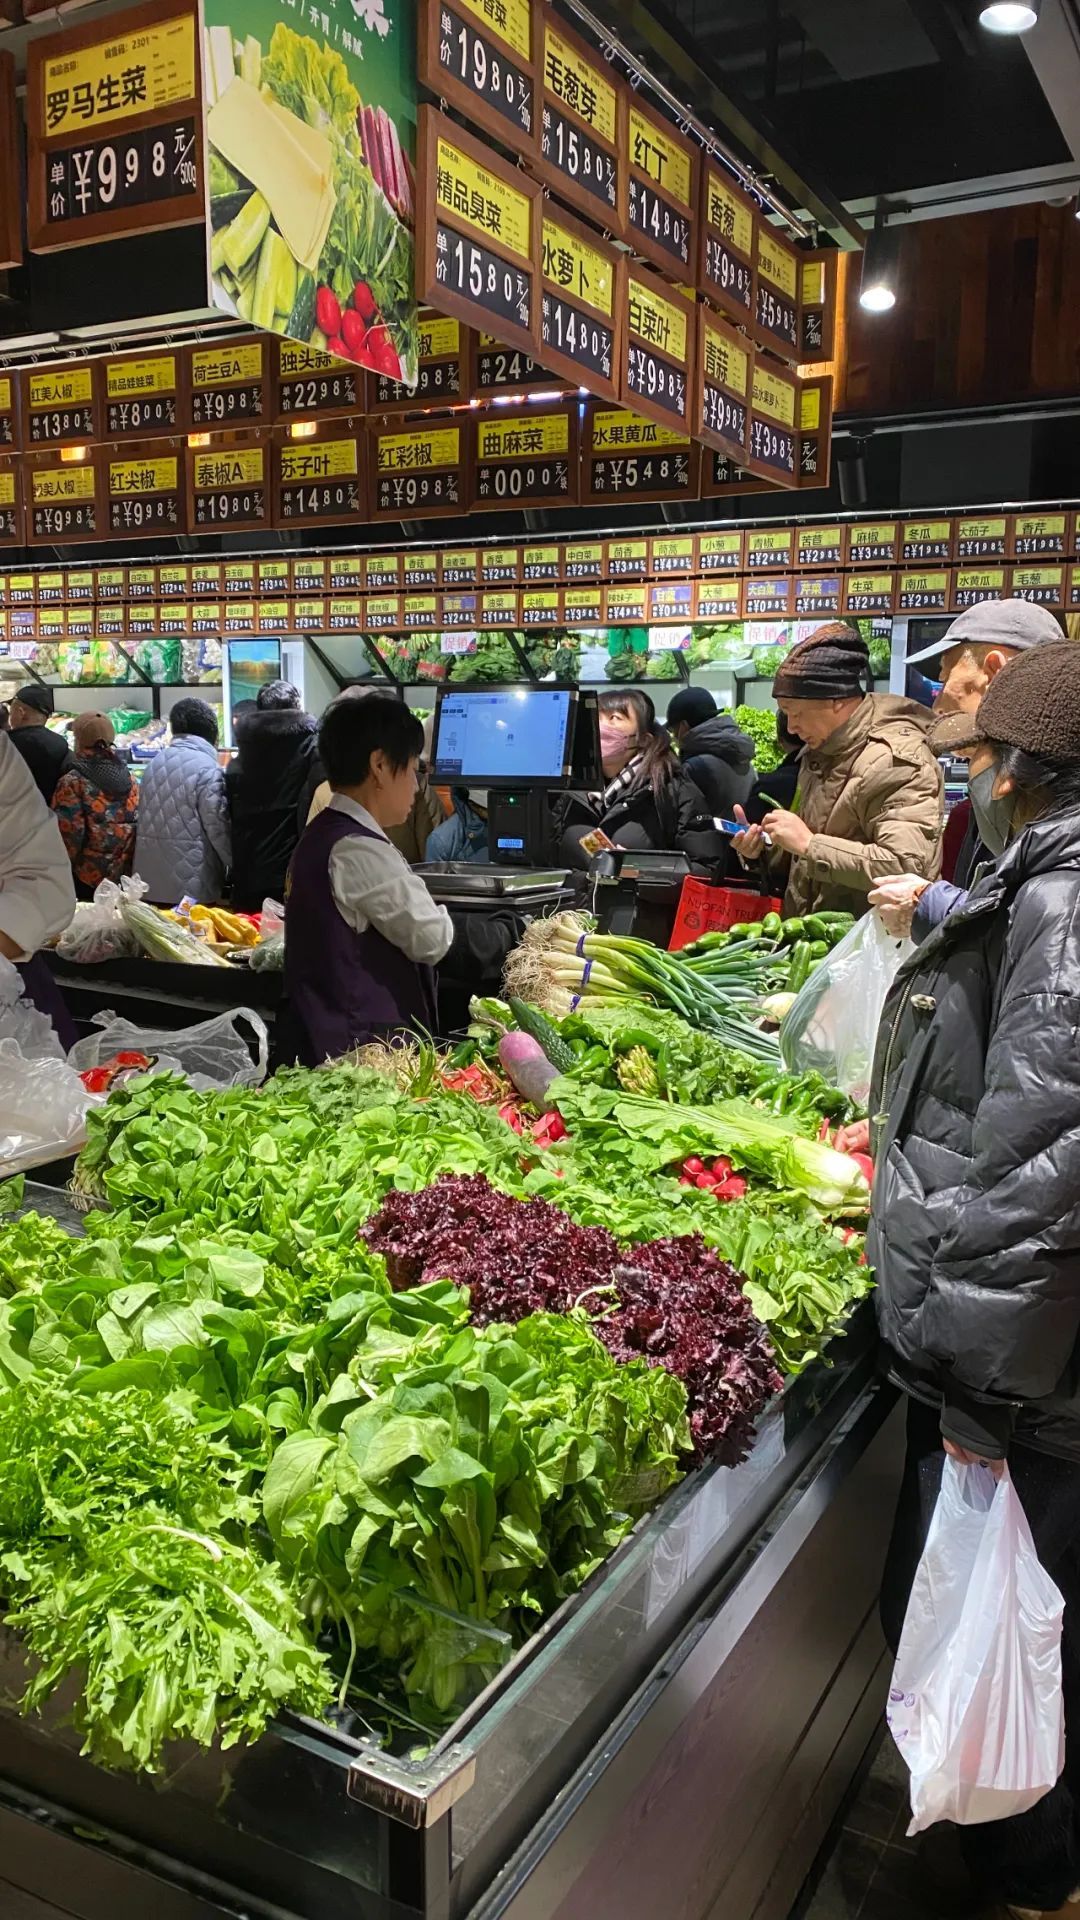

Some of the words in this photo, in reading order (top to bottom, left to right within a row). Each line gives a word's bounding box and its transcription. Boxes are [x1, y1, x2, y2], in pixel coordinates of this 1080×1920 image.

[440, 11, 452, 65] 单价
[458, 27, 514, 103] 19.80
[46, 64, 147, 129] 罗马生菜
[545, 51, 597, 124] 毛葱芽
[541, 108, 551, 155] 单价
[173, 126, 197, 187] 元/500g
[556, 122, 603, 181] 15.80
[634, 131, 668, 184] 红丁
[50, 161, 65, 217] 单价
[72, 140, 165, 214] ¥9.98
[437, 166, 502, 235] 精品臭菜
[640, 190, 679, 244] 14.80
[711, 192, 735, 242] 香葱
[436, 231, 448, 282] 单价
[541, 239, 589, 297] 水萝卜
[713, 241, 744, 290] ¥9.98
[455, 240, 512, 302] 15.80
[516, 275, 529, 327] 元/500g
[760, 287, 789, 329] ¥5.98
[542, 298, 550, 342] 单价
[554, 305, 598, 356] 14.80
[629, 297, 670, 351] 白菜叶
[805, 315, 821, 346] 元/500g
[194, 360, 241, 383] 荷兰豆A
[281, 349, 332, 373] 独头蒜
[481, 358, 491, 384] 单价
[637, 349, 674, 396] ¥9.98
[705, 340, 729, 384] 青蒜
[31, 384, 73, 402] 红美人椒
[108, 374, 155, 393] 精品娃娃菜
[282, 385, 291, 410] 单价
[294, 380, 341, 409] 22.98
[119, 403, 162, 431] ¥8.00
[203, 392, 247, 420] ¥9.98
[709, 388, 737, 430] ¥9.98
[42, 413, 81, 438] 13.80
[592, 423, 657, 445] 水果黄瓜
[754, 421, 785, 457] ¥3.98
[378, 443, 432, 468] 红彩椒
[483, 428, 544, 457] 曲麻菜
[802, 441, 816, 471] 元/500g
[198, 462, 244, 486] 泰椒A
[281, 454, 330, 478] 苏子叶
[594, 463, 604, 489] 单价
[610, 459, 669, 492] ¥5.48
[110, 470, 155, 494] 红尖椒
[381, 482, 389, 507] 单价
[393, 479, 442, 507] ¥9.98
[480, 469, 490, 495] 单价
[495, 468, 550, 496] 00.00
[122, 501, 164, 527] ¥9.98
[208, 495, 250, 519] 19.80
[284, 493, 292, 516] 单价
[297, 488, 343, 513] 14.80
[44, 508, 82, 533] ¥9.98
[908, 528, 931, 540] 冬瓜
[959, 526, 990, 537] 大茄子
[1022, 523, 1046, 535] 香芹
[851, 581, 873, 592] 生菜
[905, 579, 927, 590] 南瓜
[959, 575, 990, 587] 水黄瓜
[1017, 573, 1041, 585] 毛葱
[688, 896, 731, 917] NUOFAN
